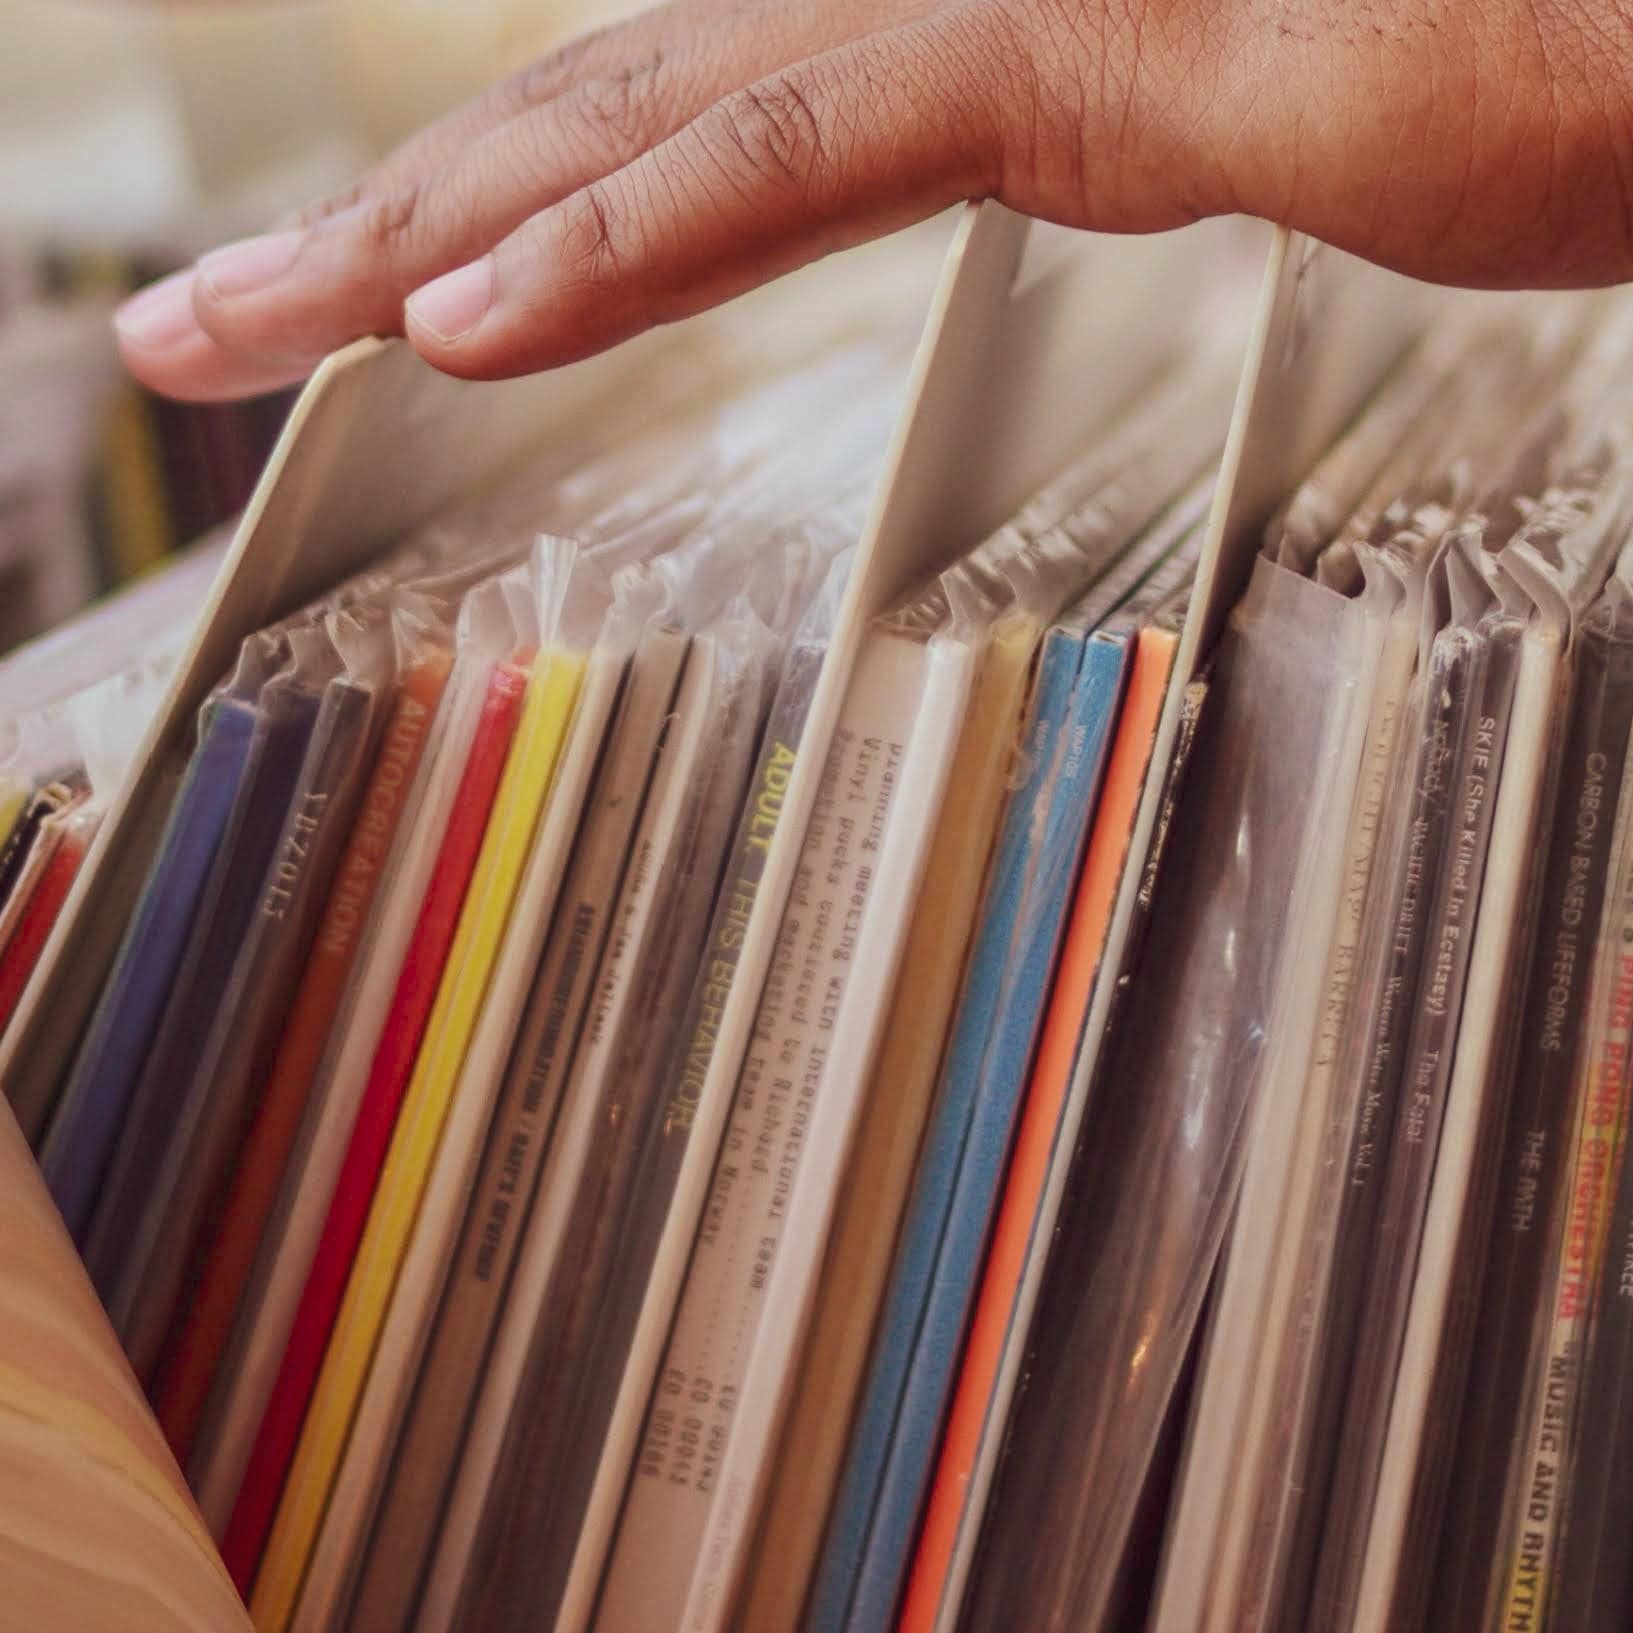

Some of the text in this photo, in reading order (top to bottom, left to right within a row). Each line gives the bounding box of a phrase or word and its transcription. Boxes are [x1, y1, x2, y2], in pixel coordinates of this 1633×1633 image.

[848, 735, 878, 804] Vinyl
[1470, 715, 1493, 772] SKIE
[323, 695, 426, 957] AUTOCREATION
[1459, 773, 1485, 826] (She
[792, 863, 816, 907] and
[1449, 828, 1477, 894] Killed
[719, 874, 759, 952] THIS
[834, 865, 869, 962] meeting
[1393, 896, 1415, 954] DRIFT
[1445, 896, 1463, 918] In
[1424, 922, 1460, 1017] Ecstasy)
[1511, 751, 1605, 1233] CARBON BASED LIFEFORMS THE PATH
[668, 958, 733, 1132] BEHAVIOR
[780, 1037, 798, 1065] to
[1416, 1048, 1436, 1087] The
[1360, 1088, 1380, 1138] Music
[1592, 1041, 1627, 1127] PONG
[752, 1077, 789, 1173] Richard
[1561, 1137, 1608, 1321] ORCHESTRA
[1527, 1460, 1556, 1522] AND
